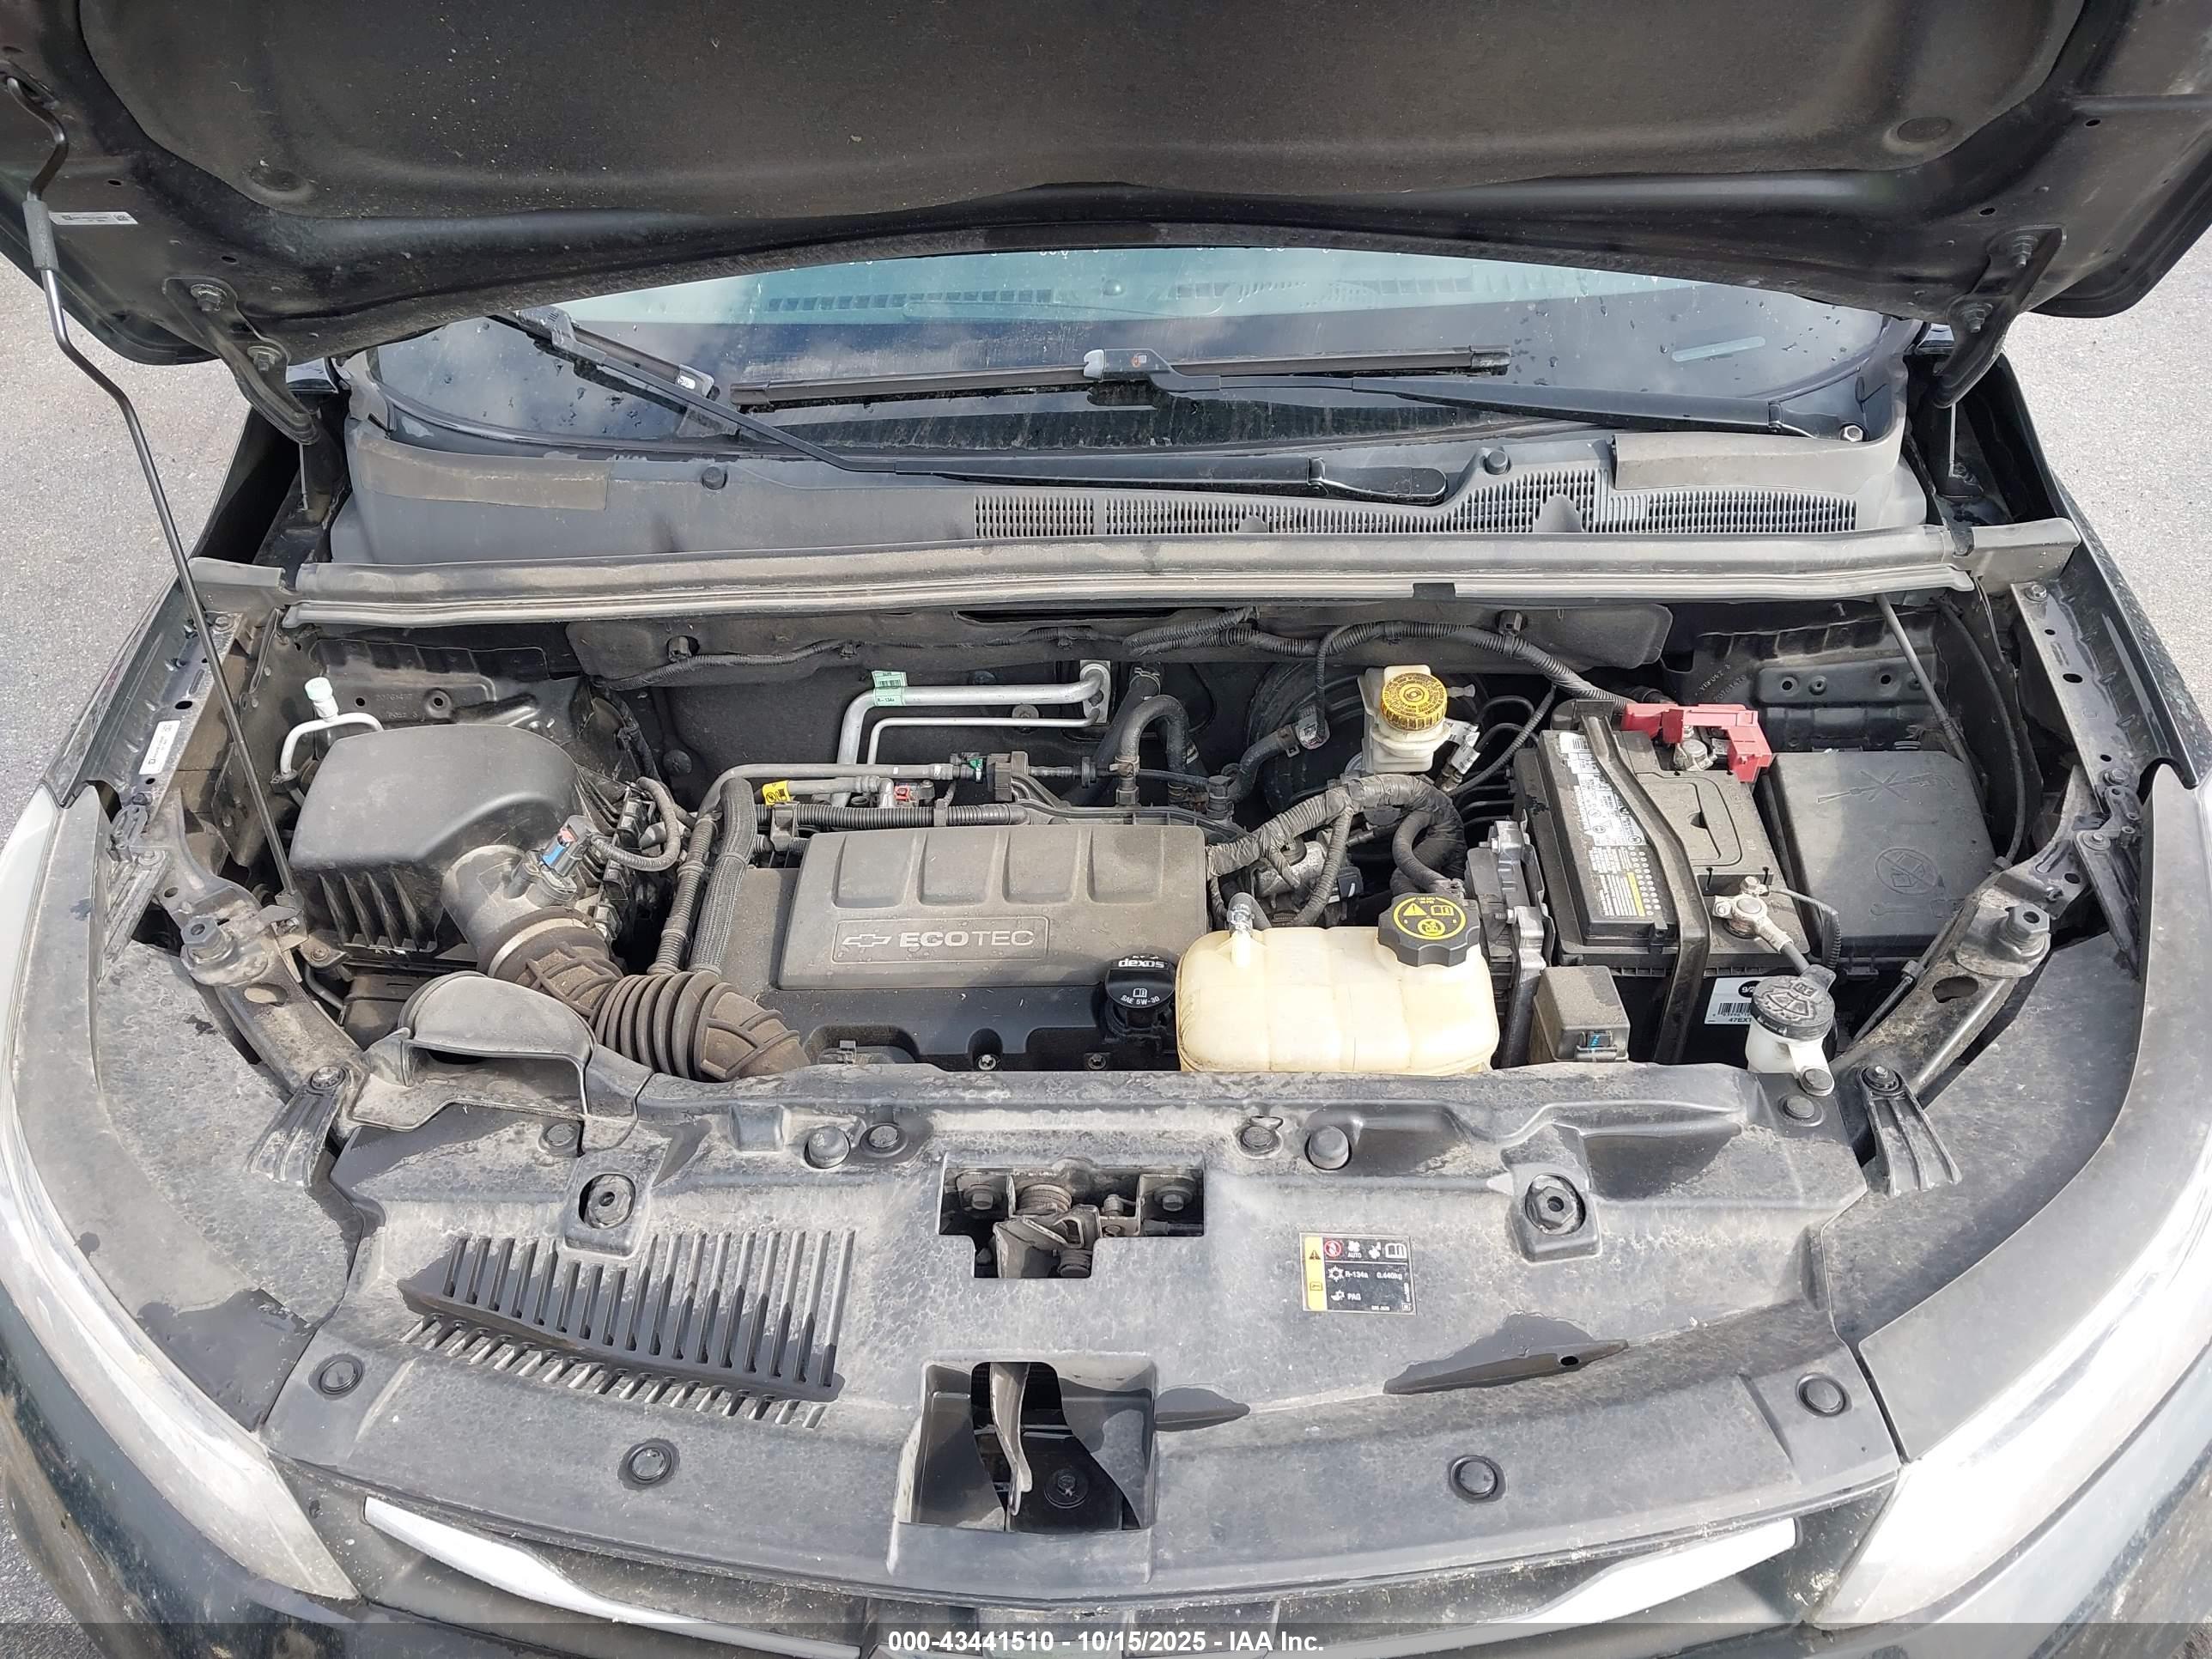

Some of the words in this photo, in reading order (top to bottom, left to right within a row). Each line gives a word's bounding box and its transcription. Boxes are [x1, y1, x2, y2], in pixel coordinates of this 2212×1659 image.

[899, 930, 1035, 948] ECOTEC
[1118, 957, 1165, 969] dexos
[1121, 994, 1134, 1004] SAE
[1136, 996, 1160, 1005] 5W-30
[1345, 1270, 1369, 1279] R-134a
[1347, 1292, 1361, 1301] PAG
